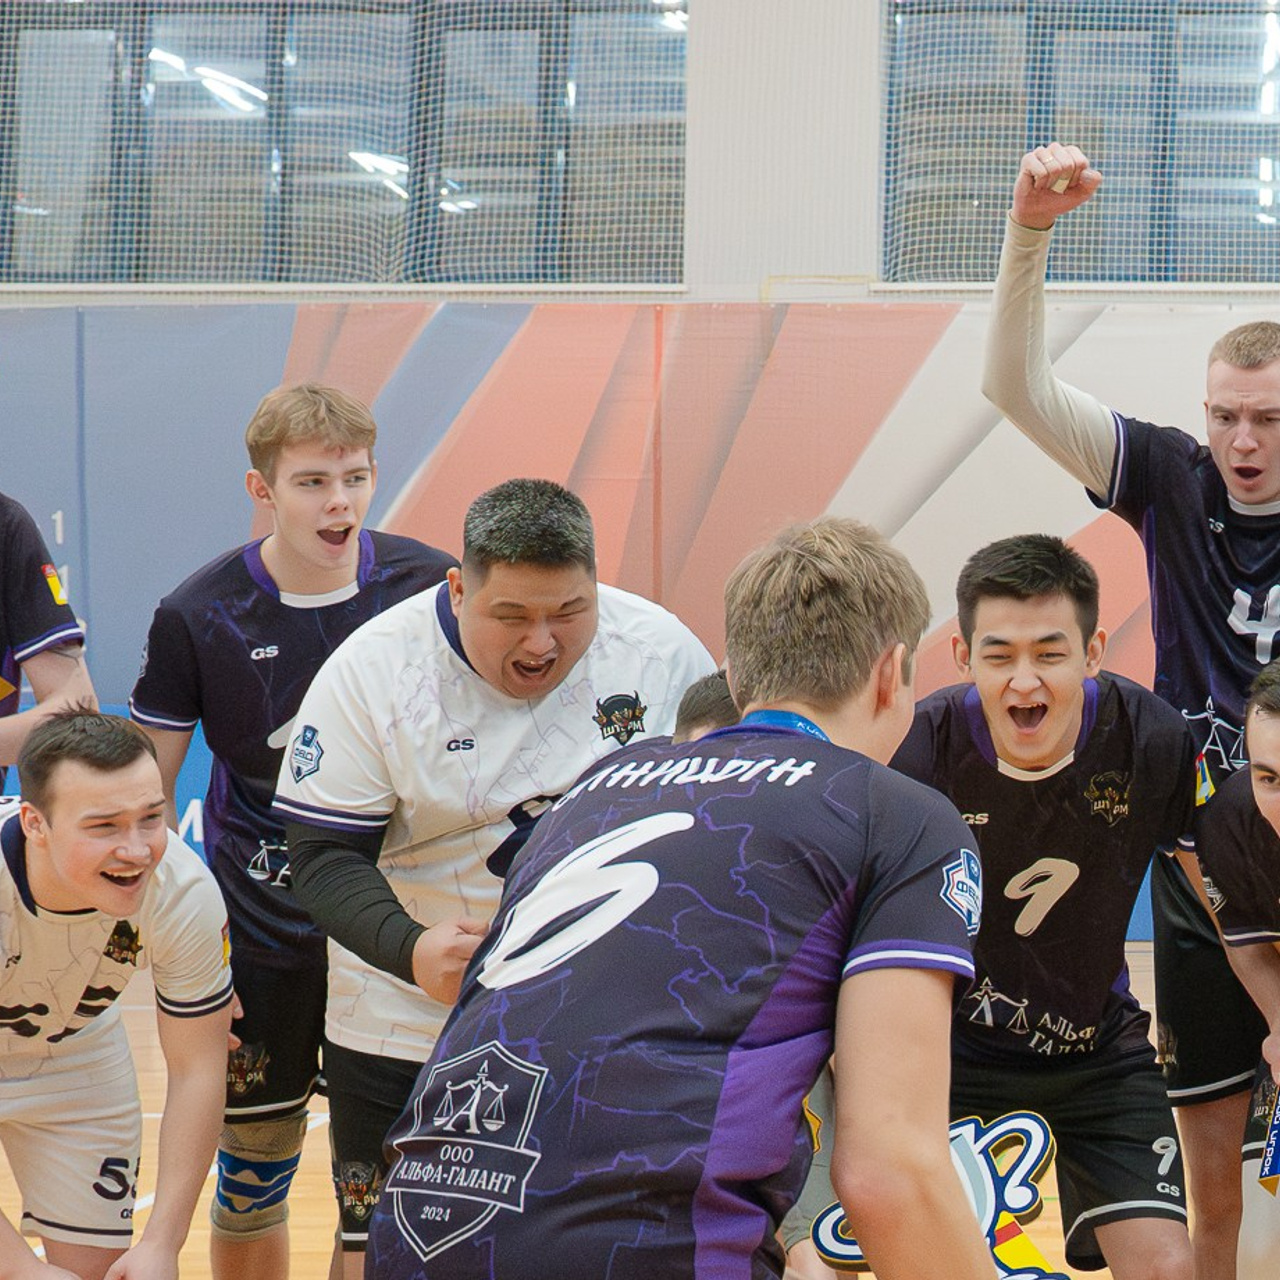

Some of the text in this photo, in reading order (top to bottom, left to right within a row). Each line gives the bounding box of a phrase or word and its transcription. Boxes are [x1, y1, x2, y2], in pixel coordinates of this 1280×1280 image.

[250, 645, 279, 661] GS
[446, 737, 475, 752] GS
[962, 812, 990, 826] GS
[476, 811, 695, 991] 6
[1003, 857, 1081, 937] 9
[439, 1144, 474, 1164] ООО
[1151, 1135, 1179, 1176] 9
[92, 1156, 141, 1201] 5
[396, 1160, 516, 1195] АЛЬФА-ГАЛАНТ
[1156, 1181, 1181, 1197] GS
[420, 1205, 451, 1222] 2024
